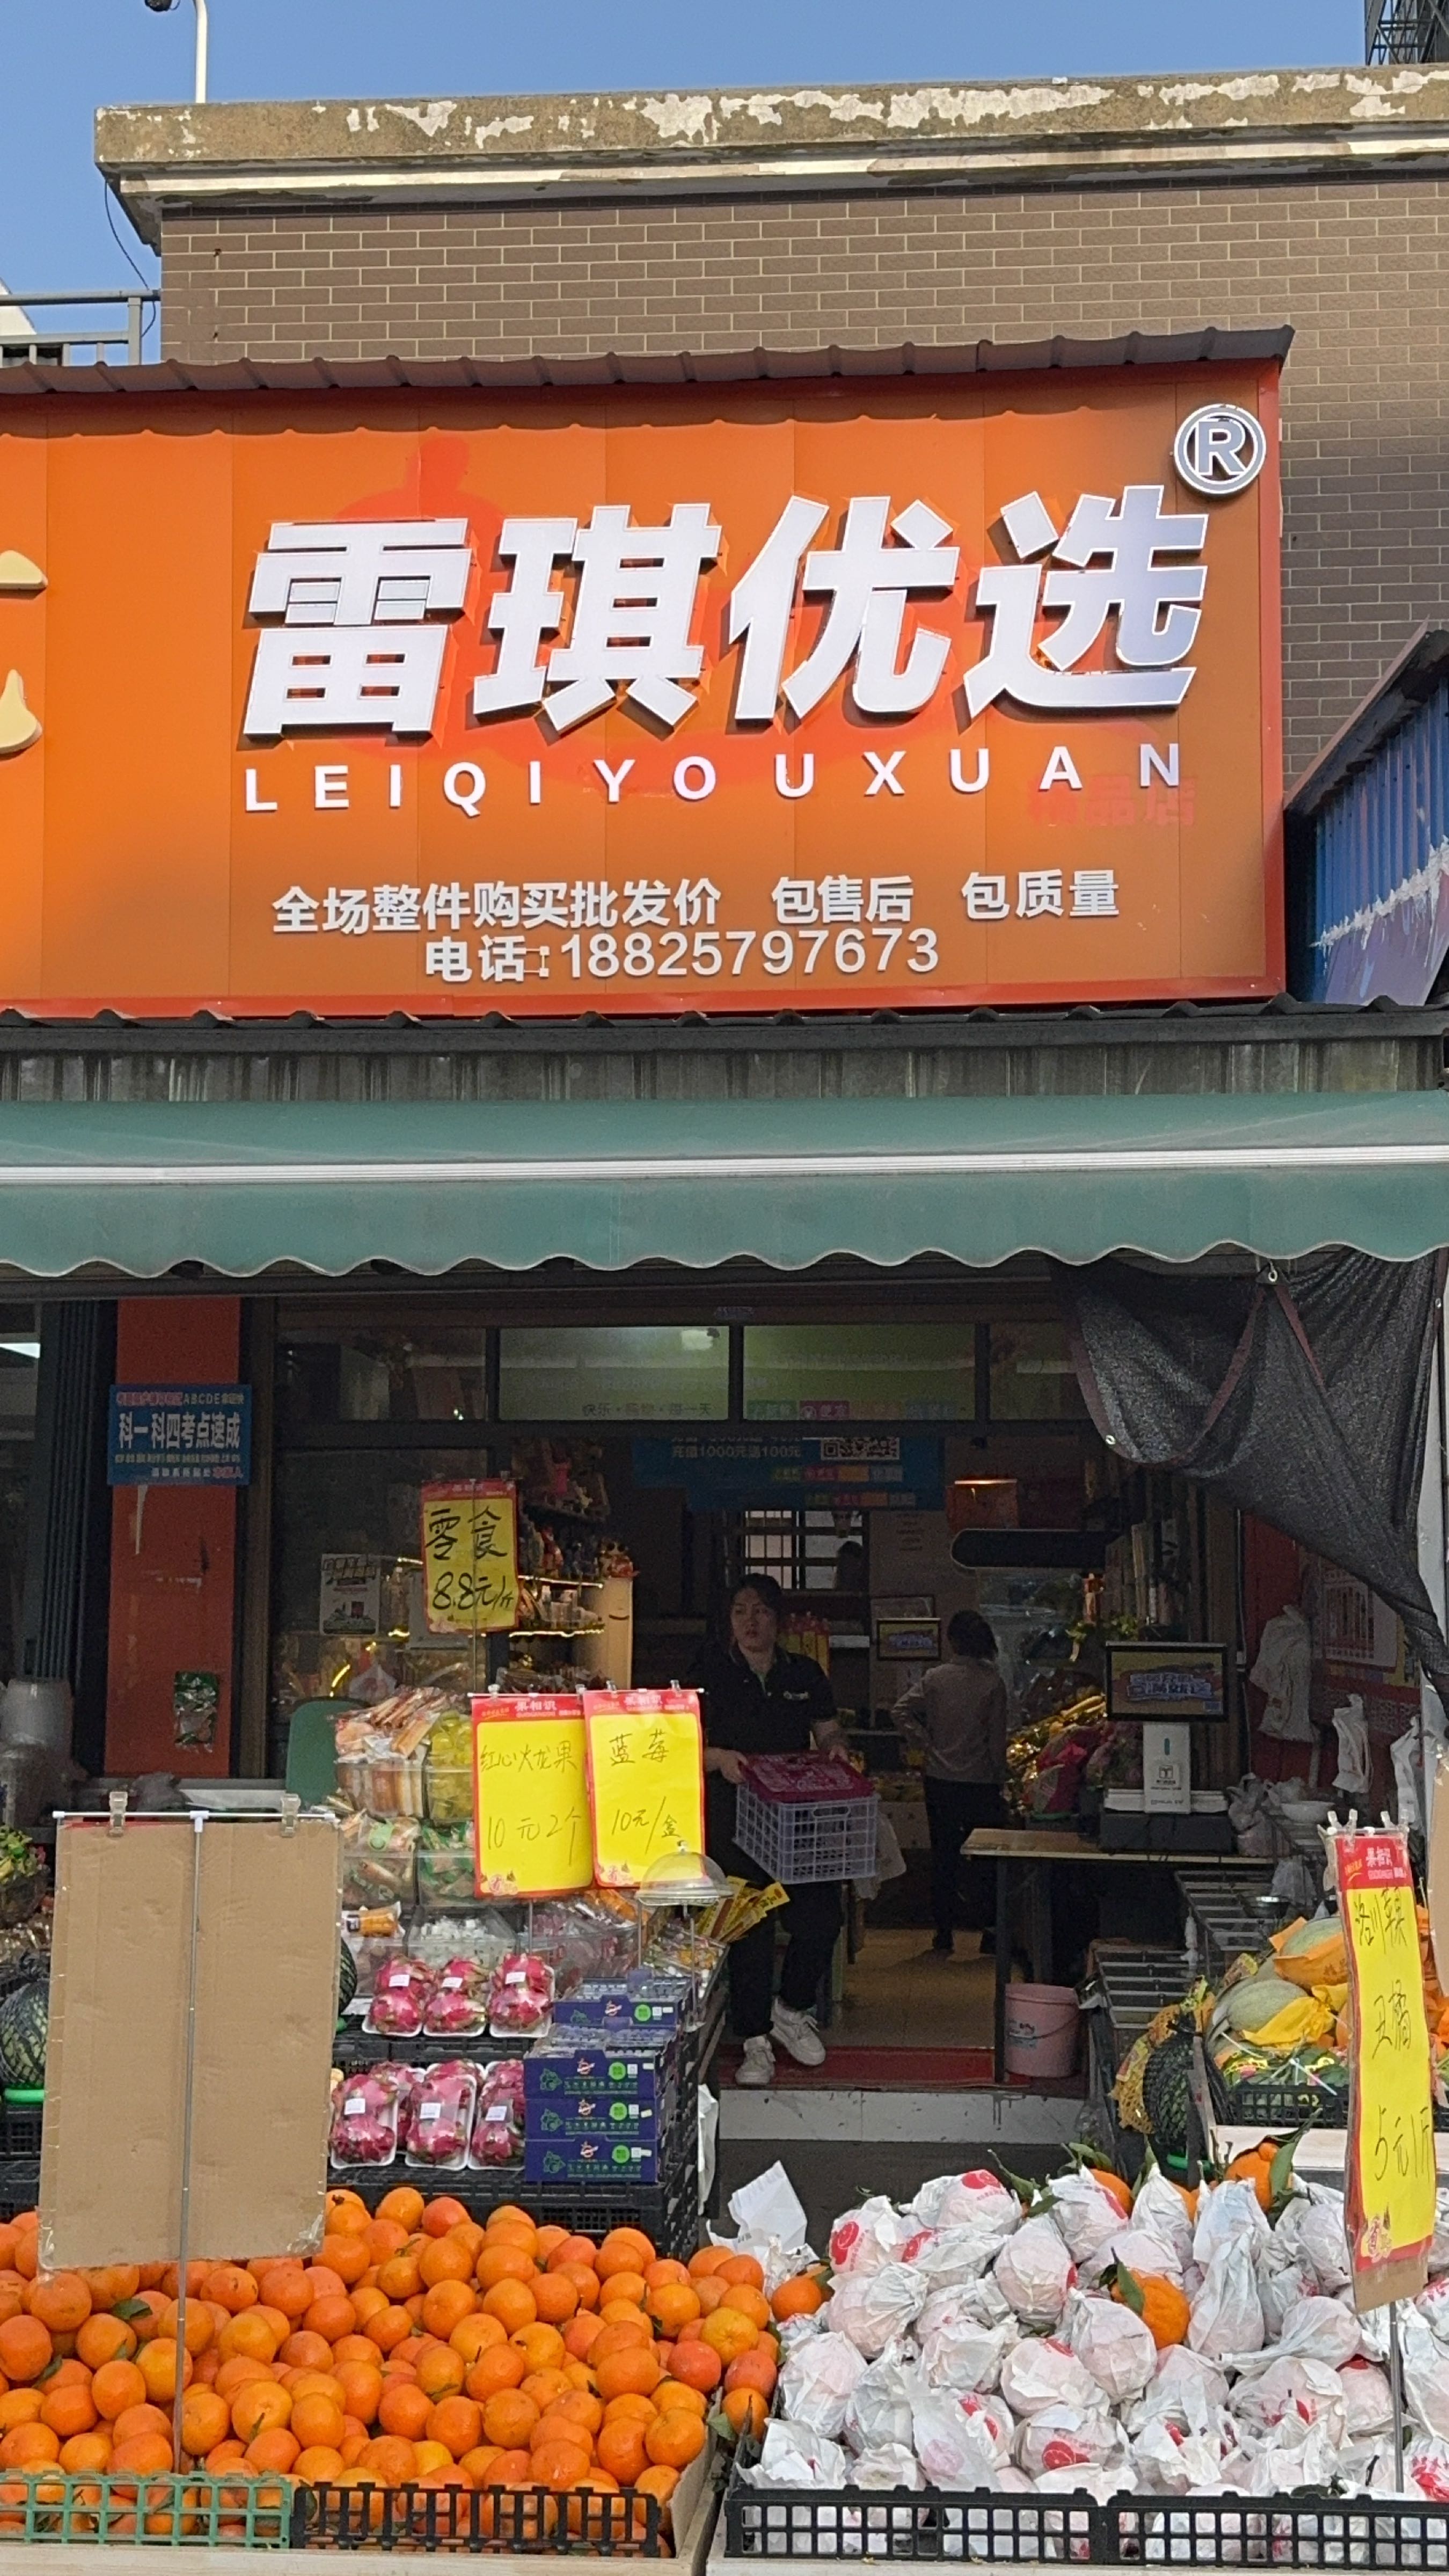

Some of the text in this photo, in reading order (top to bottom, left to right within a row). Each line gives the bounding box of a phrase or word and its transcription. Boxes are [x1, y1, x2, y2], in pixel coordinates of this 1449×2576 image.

[243, 486, 1209, 737] 雷琪优选
[272, 870, 1119, 936] 全场整件购买批发价 包售后 包质量
[119, 1412, 240, 1449] 科一科四考点速成
[426, 1506, 508, 1561] 零食
[480, 1740, 577, 1773] 红心火龙果
[610, 1729, 669, 1767] 蓝莓
